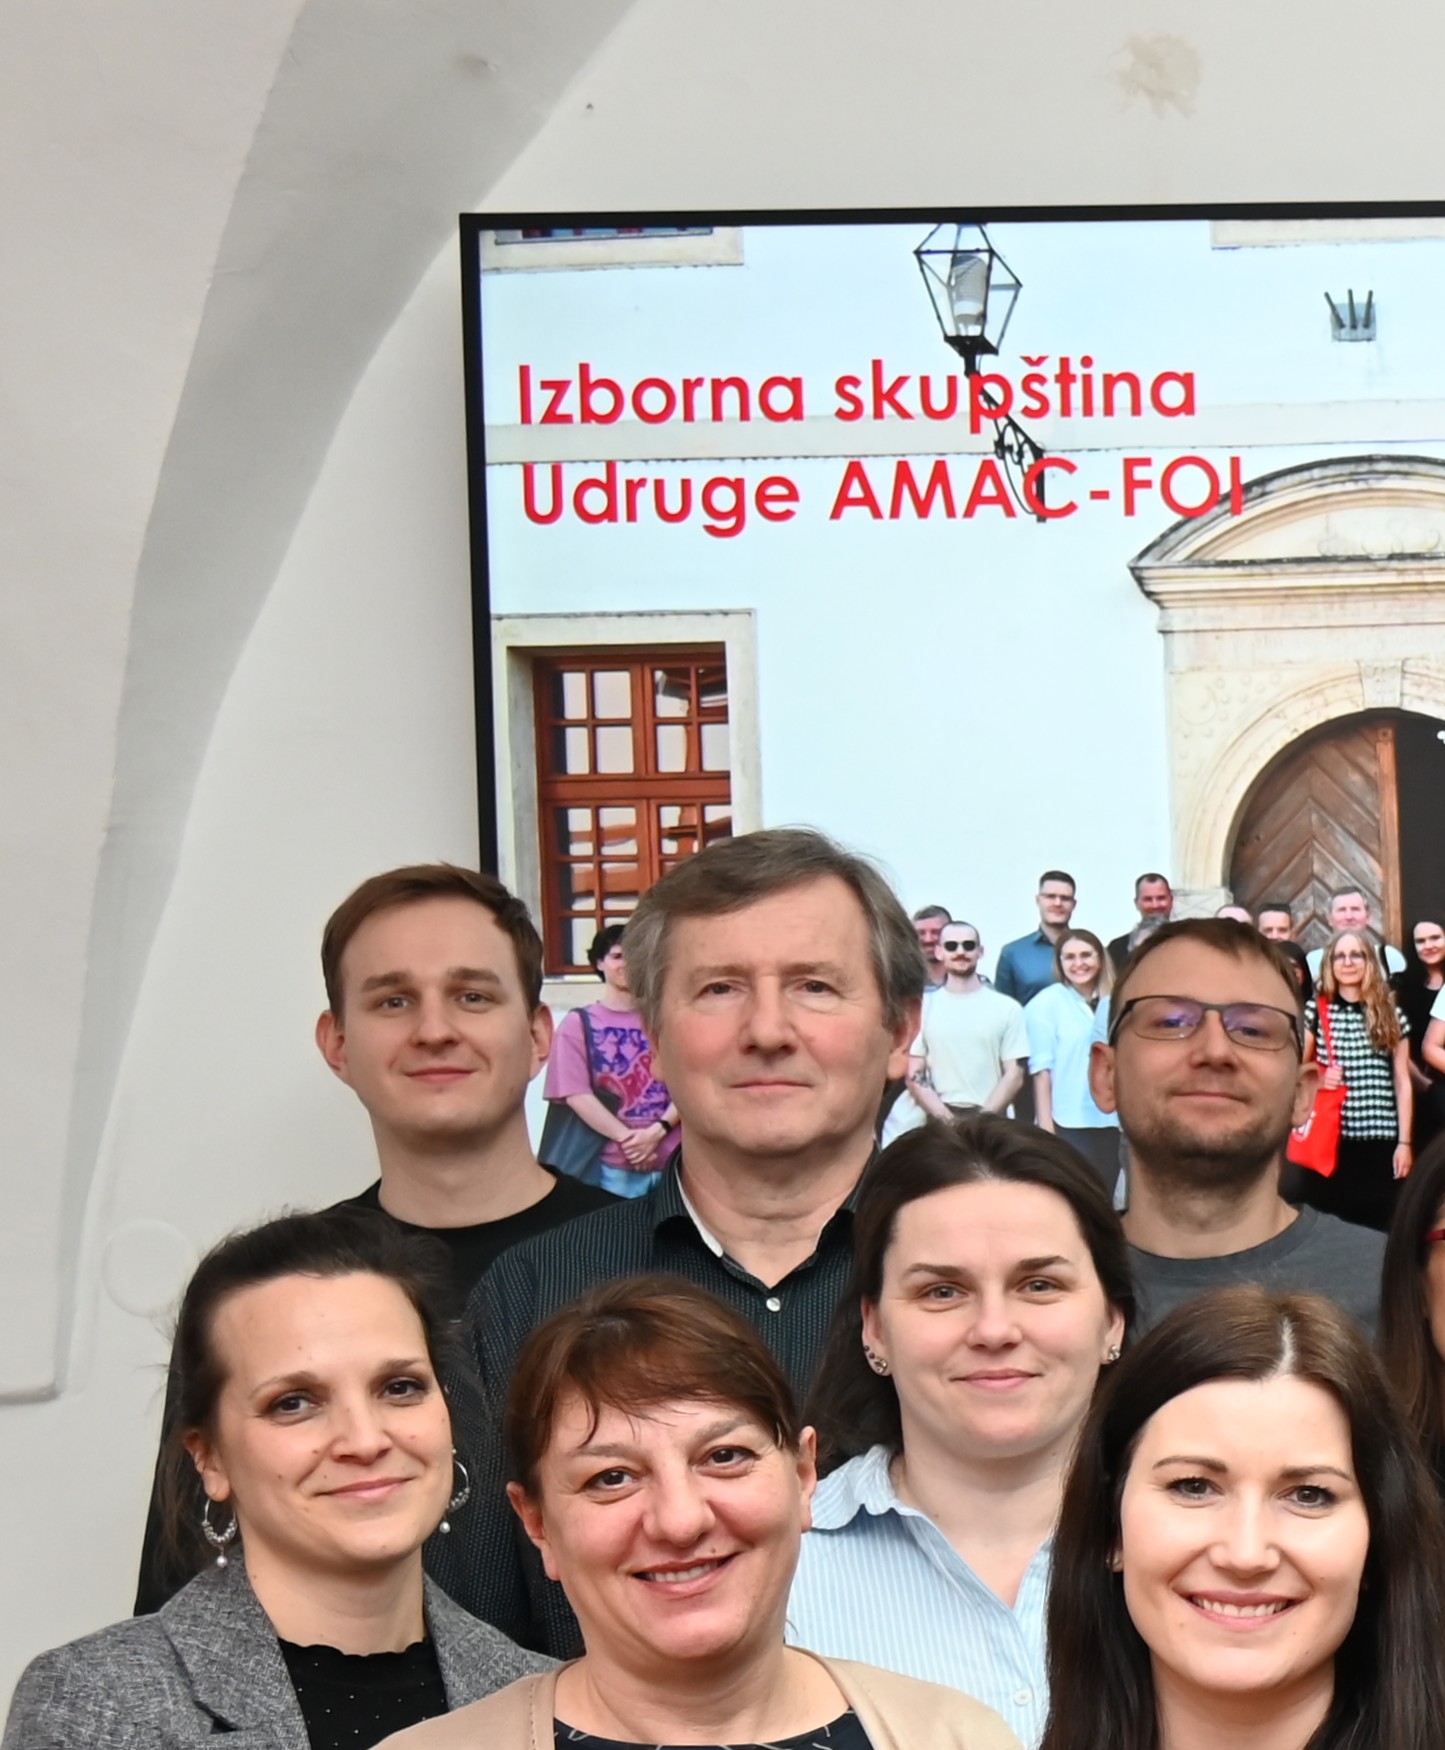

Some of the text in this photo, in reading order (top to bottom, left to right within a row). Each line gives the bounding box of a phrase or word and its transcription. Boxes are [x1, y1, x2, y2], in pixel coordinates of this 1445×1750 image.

[519, 355, 1196, 434] Izborna skupština
[521, 456, 1242, 538] Udruge AMAC-FOI
